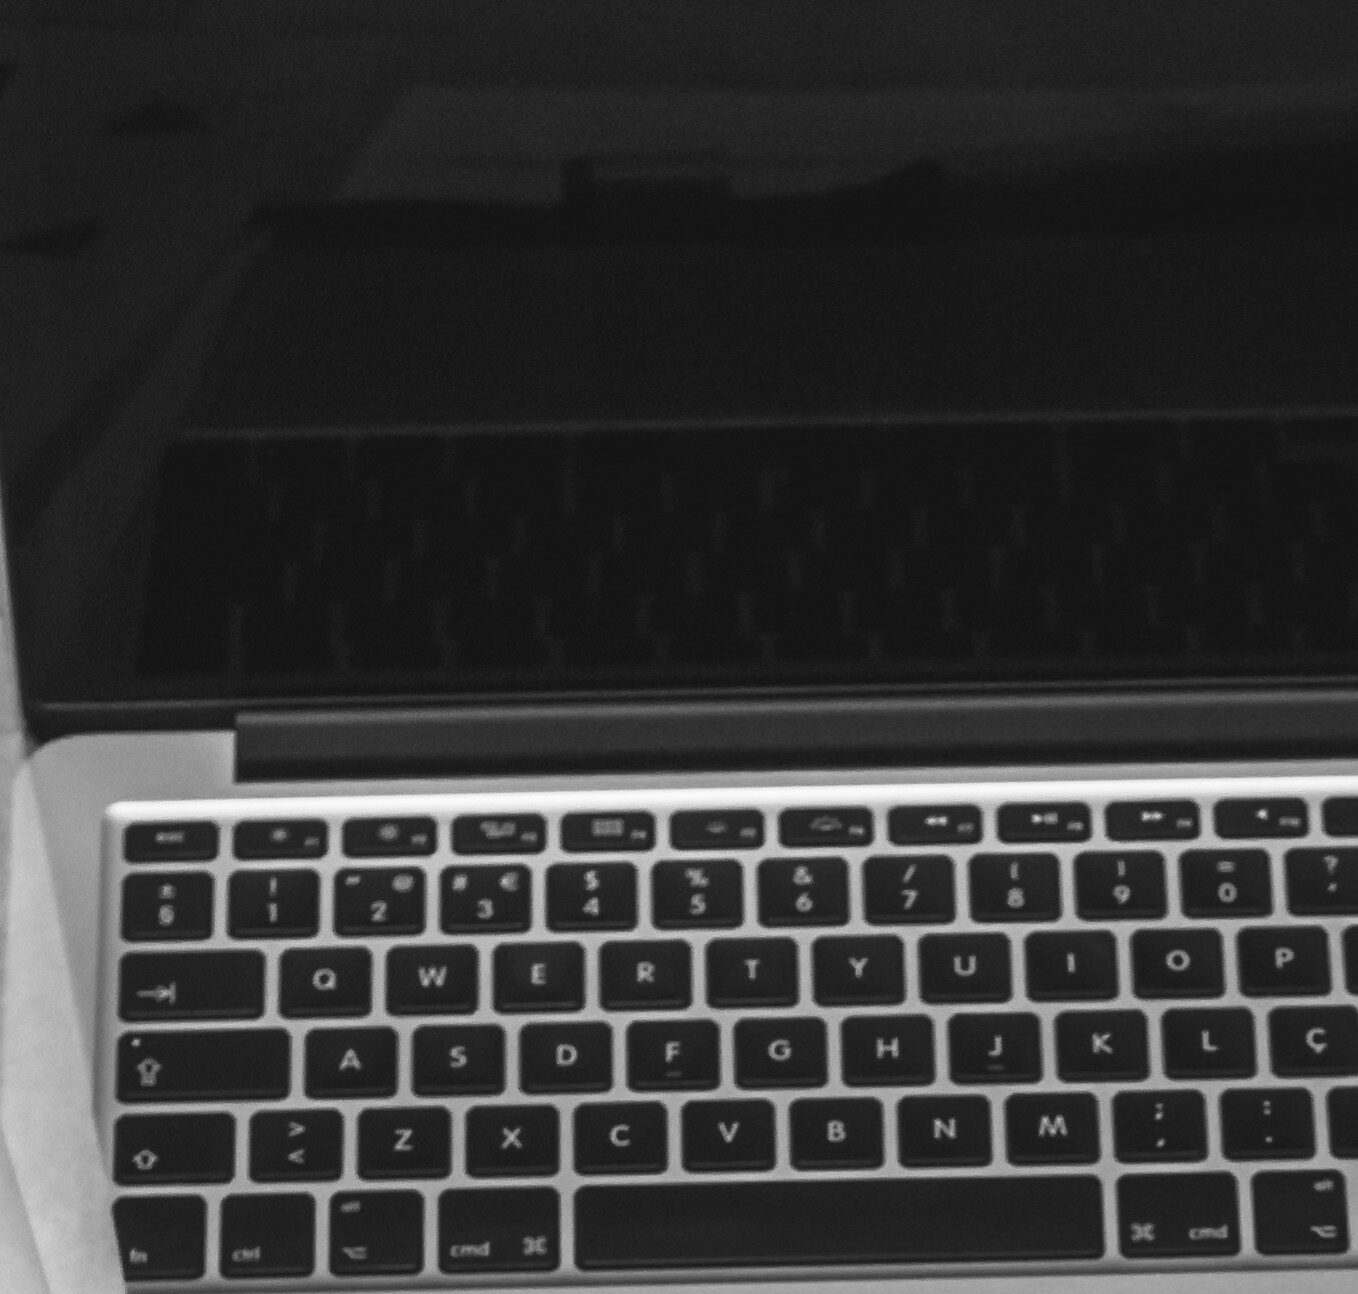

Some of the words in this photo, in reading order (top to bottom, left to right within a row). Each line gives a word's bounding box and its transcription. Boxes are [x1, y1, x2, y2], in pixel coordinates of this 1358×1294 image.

[688, 892, 709, 916] 5
[793, 891, 815, 913] 6
[901, 888, 920, 911] 7
[1006, 886, 1027, 910] 8
[1111, 883, 1133, 906] 9
[1216, 880, 1239, 904] 0
[267, 901, 280, 924] 1
[369, 899, 389, 924] 2
[476, 897, 496, 921] 3
[580, 895, 602, 917] 4
[743, 956, 762, 982] T
[847, 955, 870, 979] Y
[951, 953, 978, 978] U
[1066, 951, 1077, 975] I
[1163, 947, 1193, 973] O
[1273, 946, 1296, 970] P
[310, 966, 339, 992] Q
[417, 964, 449, 989] W
[529, 961, 548, 986] E
[635, 960, 657, 985] R
[663, 1039, 682, 1065] F
[766, 1037, 794, 1063] G
[874, 1035, 901, 1060] H
[986, 1034, 1005, 1059] J
[1090, 1031, 1114, 1056] K
[1199, 1028, 1220, 1054] L
[1304, 1025, 1330, 1056] Ç
[337, 1047, 363, 1072] A
[447, 1045, 469, 1069] S
[553, 1042, 580, 1067] D
[286, 1119, 307, 1139] >
[499, 1125, 524, 1151] X
[608, 1122, 632, 1149] C
[716, 1119, 741, 1145] V
[825, 1118, 848, 1144] B
[931, 1116, 959, 1141] N
[1036, 1113, 1070, 1139] M
[392, 1126, 415, 1153] Z
[286, 1147, 307, 1166] <
[1187, 1222, 1230, 1242] cmd
[127, 1245, 150, 1266] fn
[229, 1244, 263, 1264] ctrl
[448, 1239, 492, 1260] cmd
